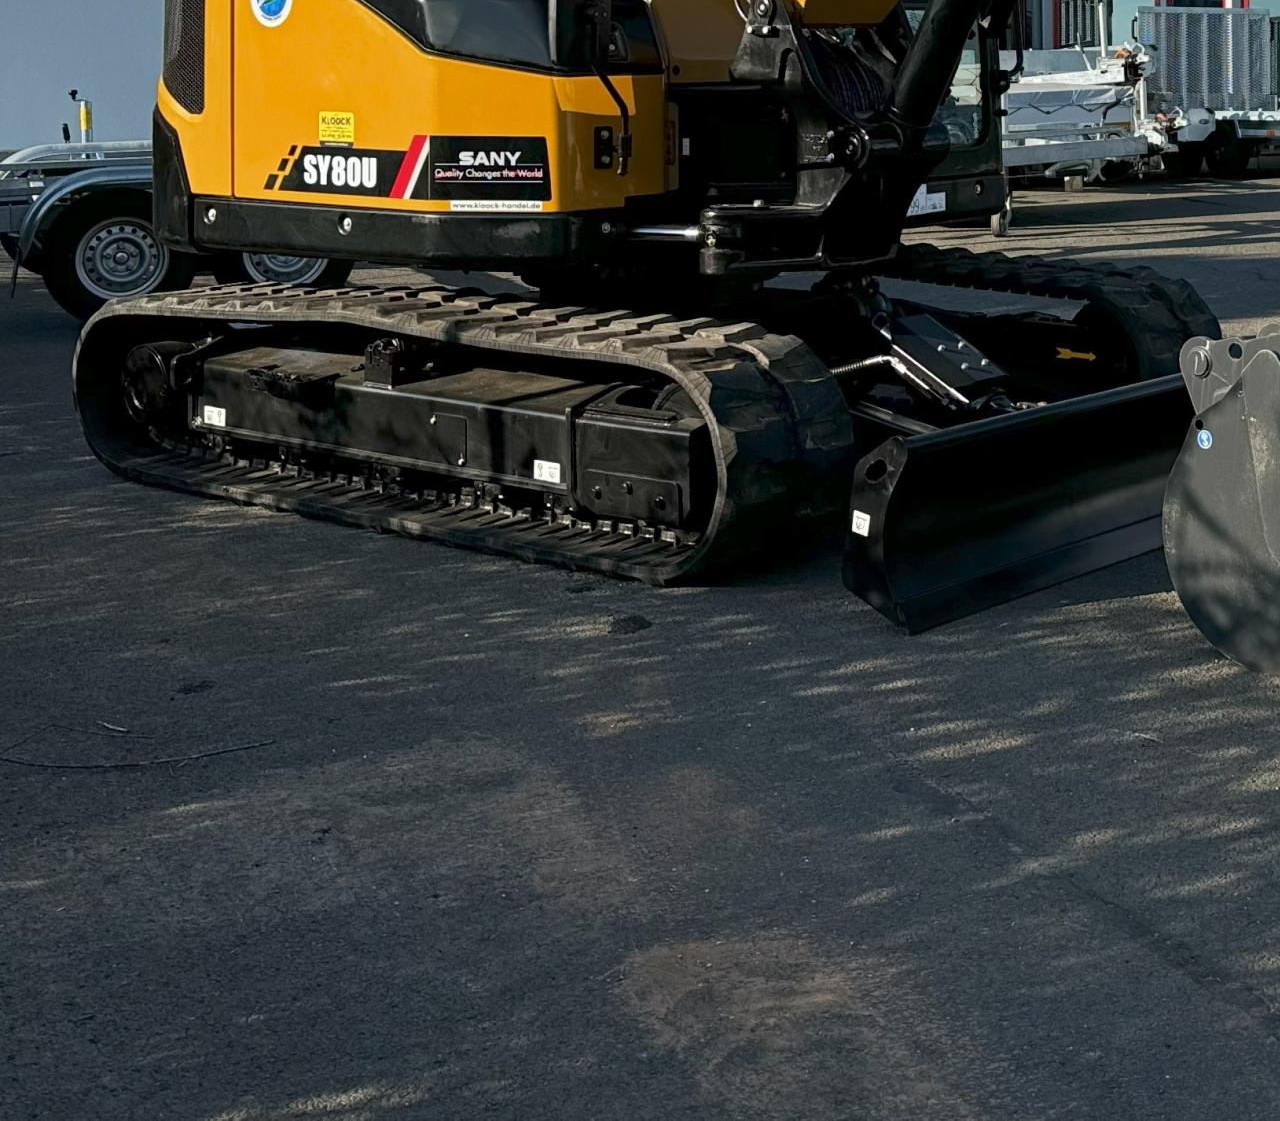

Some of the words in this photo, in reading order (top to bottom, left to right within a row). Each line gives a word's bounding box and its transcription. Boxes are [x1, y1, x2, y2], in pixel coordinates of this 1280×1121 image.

[321, 116, 352, 126] KLOOCK
[458, 151, 522, 166] SANY
[303, 154, 378, 188] SY80U
[434, 168, 464, 180] Quality
[465, 168, 501, 180] Changes
[502, 168, 516, 178] the
[517, 168, 543, 178] World
[452, 202, 541, 210] www.kloock-handel.de
